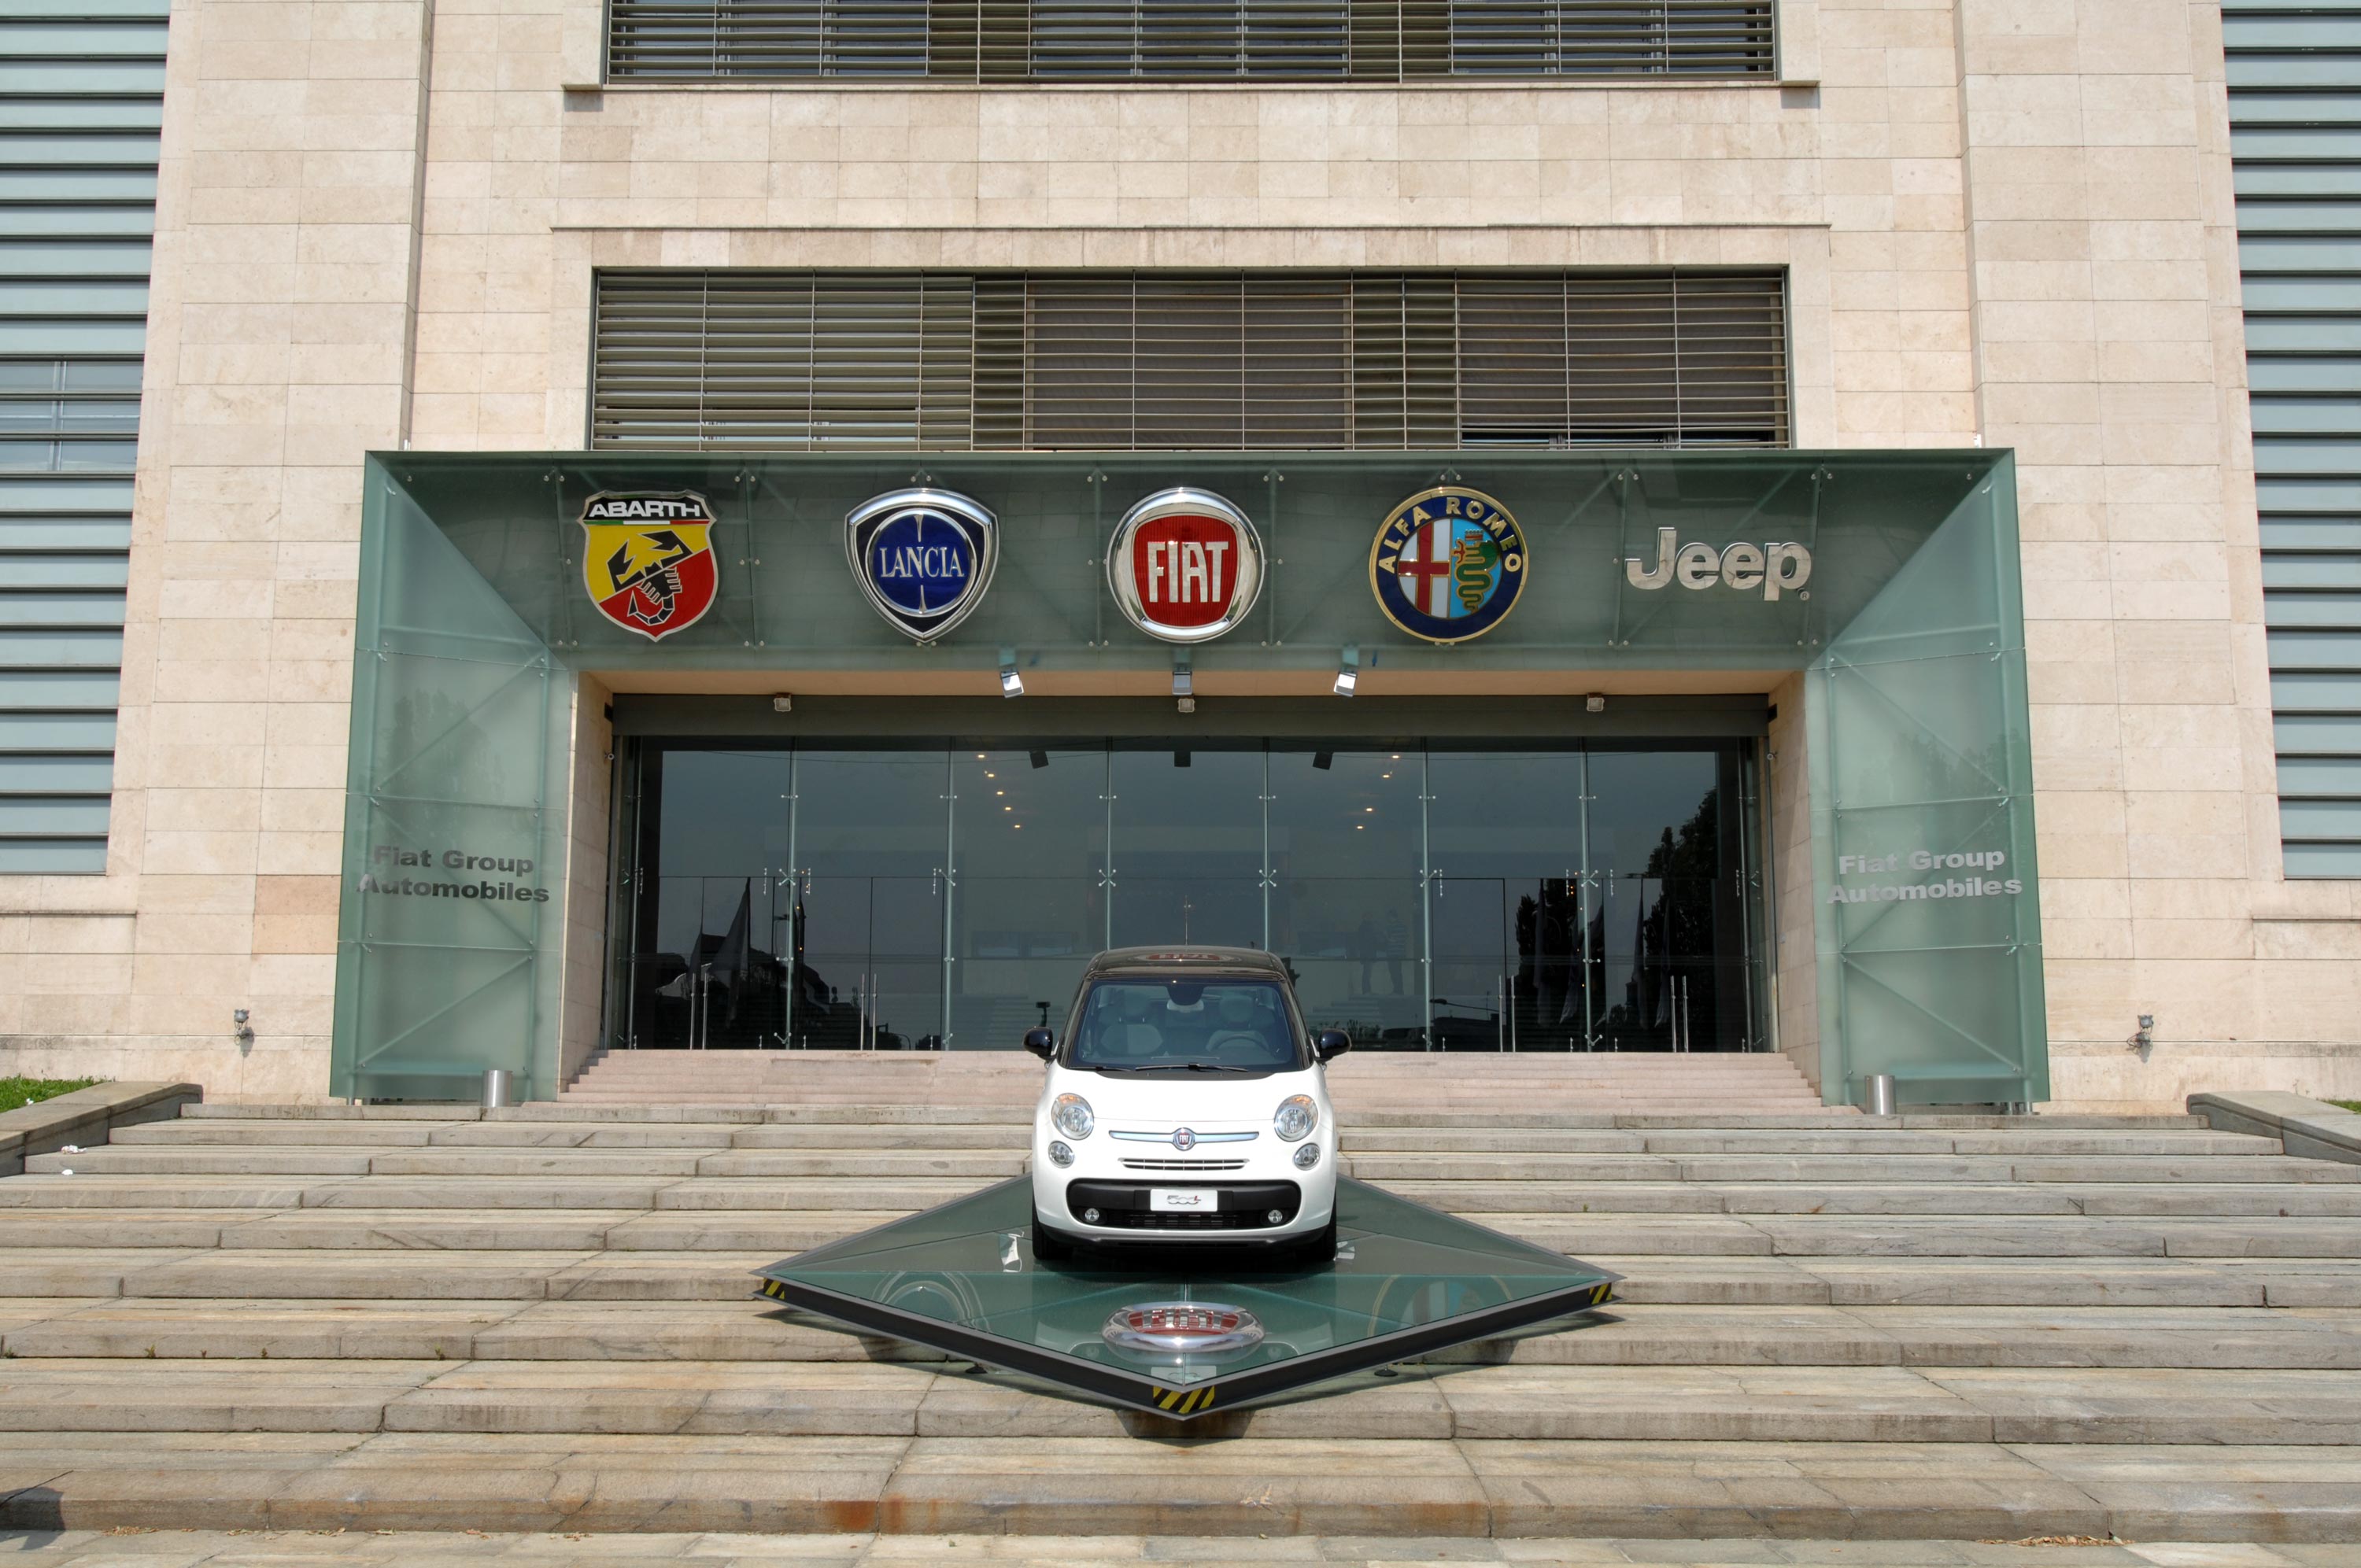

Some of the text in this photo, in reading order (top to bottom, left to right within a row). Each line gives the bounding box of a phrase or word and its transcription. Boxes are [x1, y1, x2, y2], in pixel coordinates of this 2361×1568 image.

[589, 500, 700, 518] ABARTH
[1378, 496, 1522, 574] ALFA ROMEO
[879, 546, 965, 577] LANCIA
[1147, 540, 1229, 603] FIAT
[1624, 526, 1811, 601] Jeep
[373, 844, 534, 877] Fiat Group
[1838, 850, 2005, 875] Fiat Group
[357, 873, 550, 903] Automobiles
[1826, 876, 2023, 904] Automobiles
